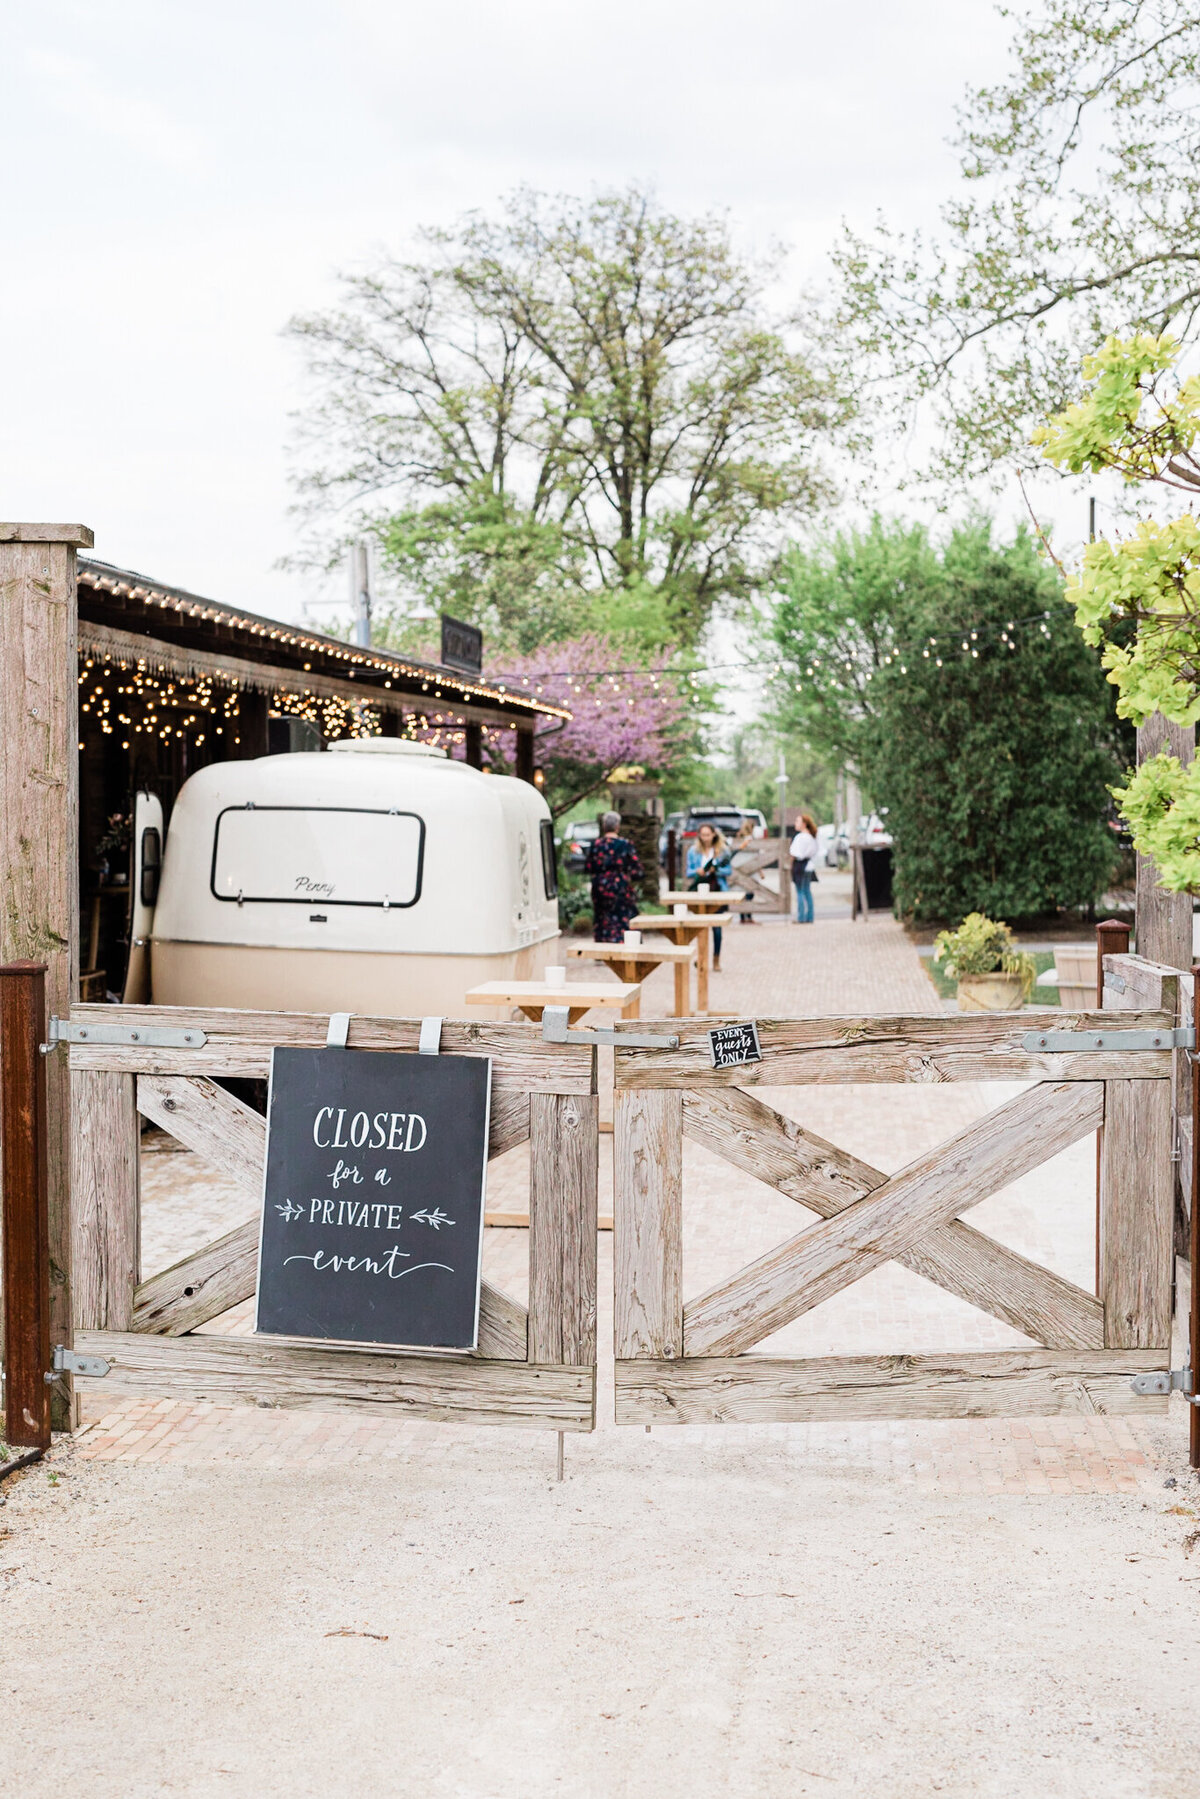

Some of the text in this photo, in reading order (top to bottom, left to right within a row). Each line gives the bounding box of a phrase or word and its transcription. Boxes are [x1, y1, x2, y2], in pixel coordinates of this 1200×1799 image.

[294, 876, 336, 897] Penny
[715, 1034, 752, 1057] guests
[717, 1027, 745, 1040] EVENT
[720, 1048, 748, 1064] ONLY
[312, 1106, 428, 1152] CLOSED
[327, 1159, 392, 1189] for a
[308, 1198, 403, 1229] PRIVATE
[283, 1245, 455, 1279] event
